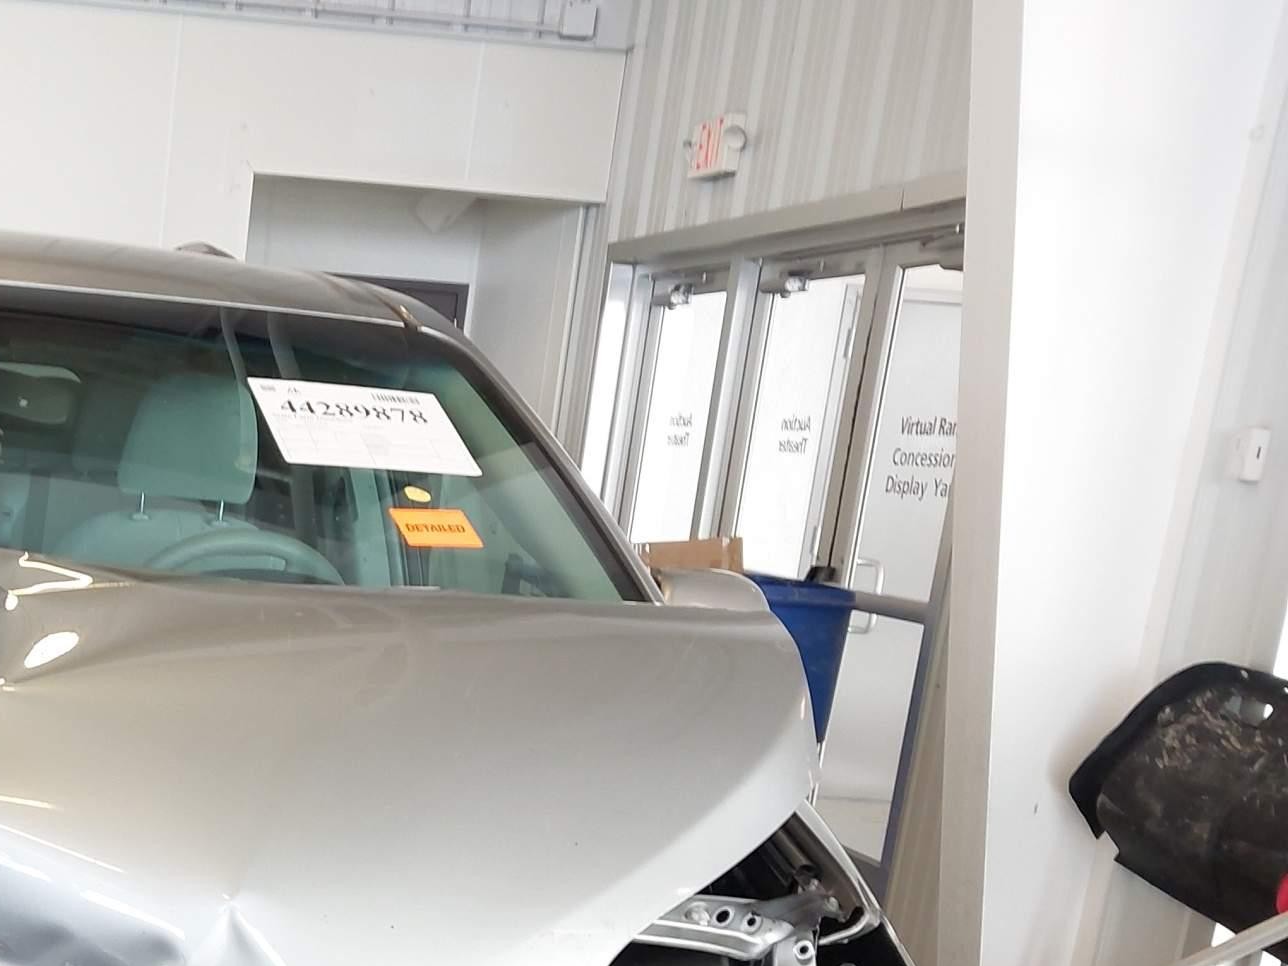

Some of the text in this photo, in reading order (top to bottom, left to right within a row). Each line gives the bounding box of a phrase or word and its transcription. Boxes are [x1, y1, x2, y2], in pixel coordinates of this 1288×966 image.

[280, 399, 428, 424] 44289878
[900, 415, 937, 436] Virtual
[885, 473, 949, 502] Display Ya
[404, 522, 467, 534] DETAILED
